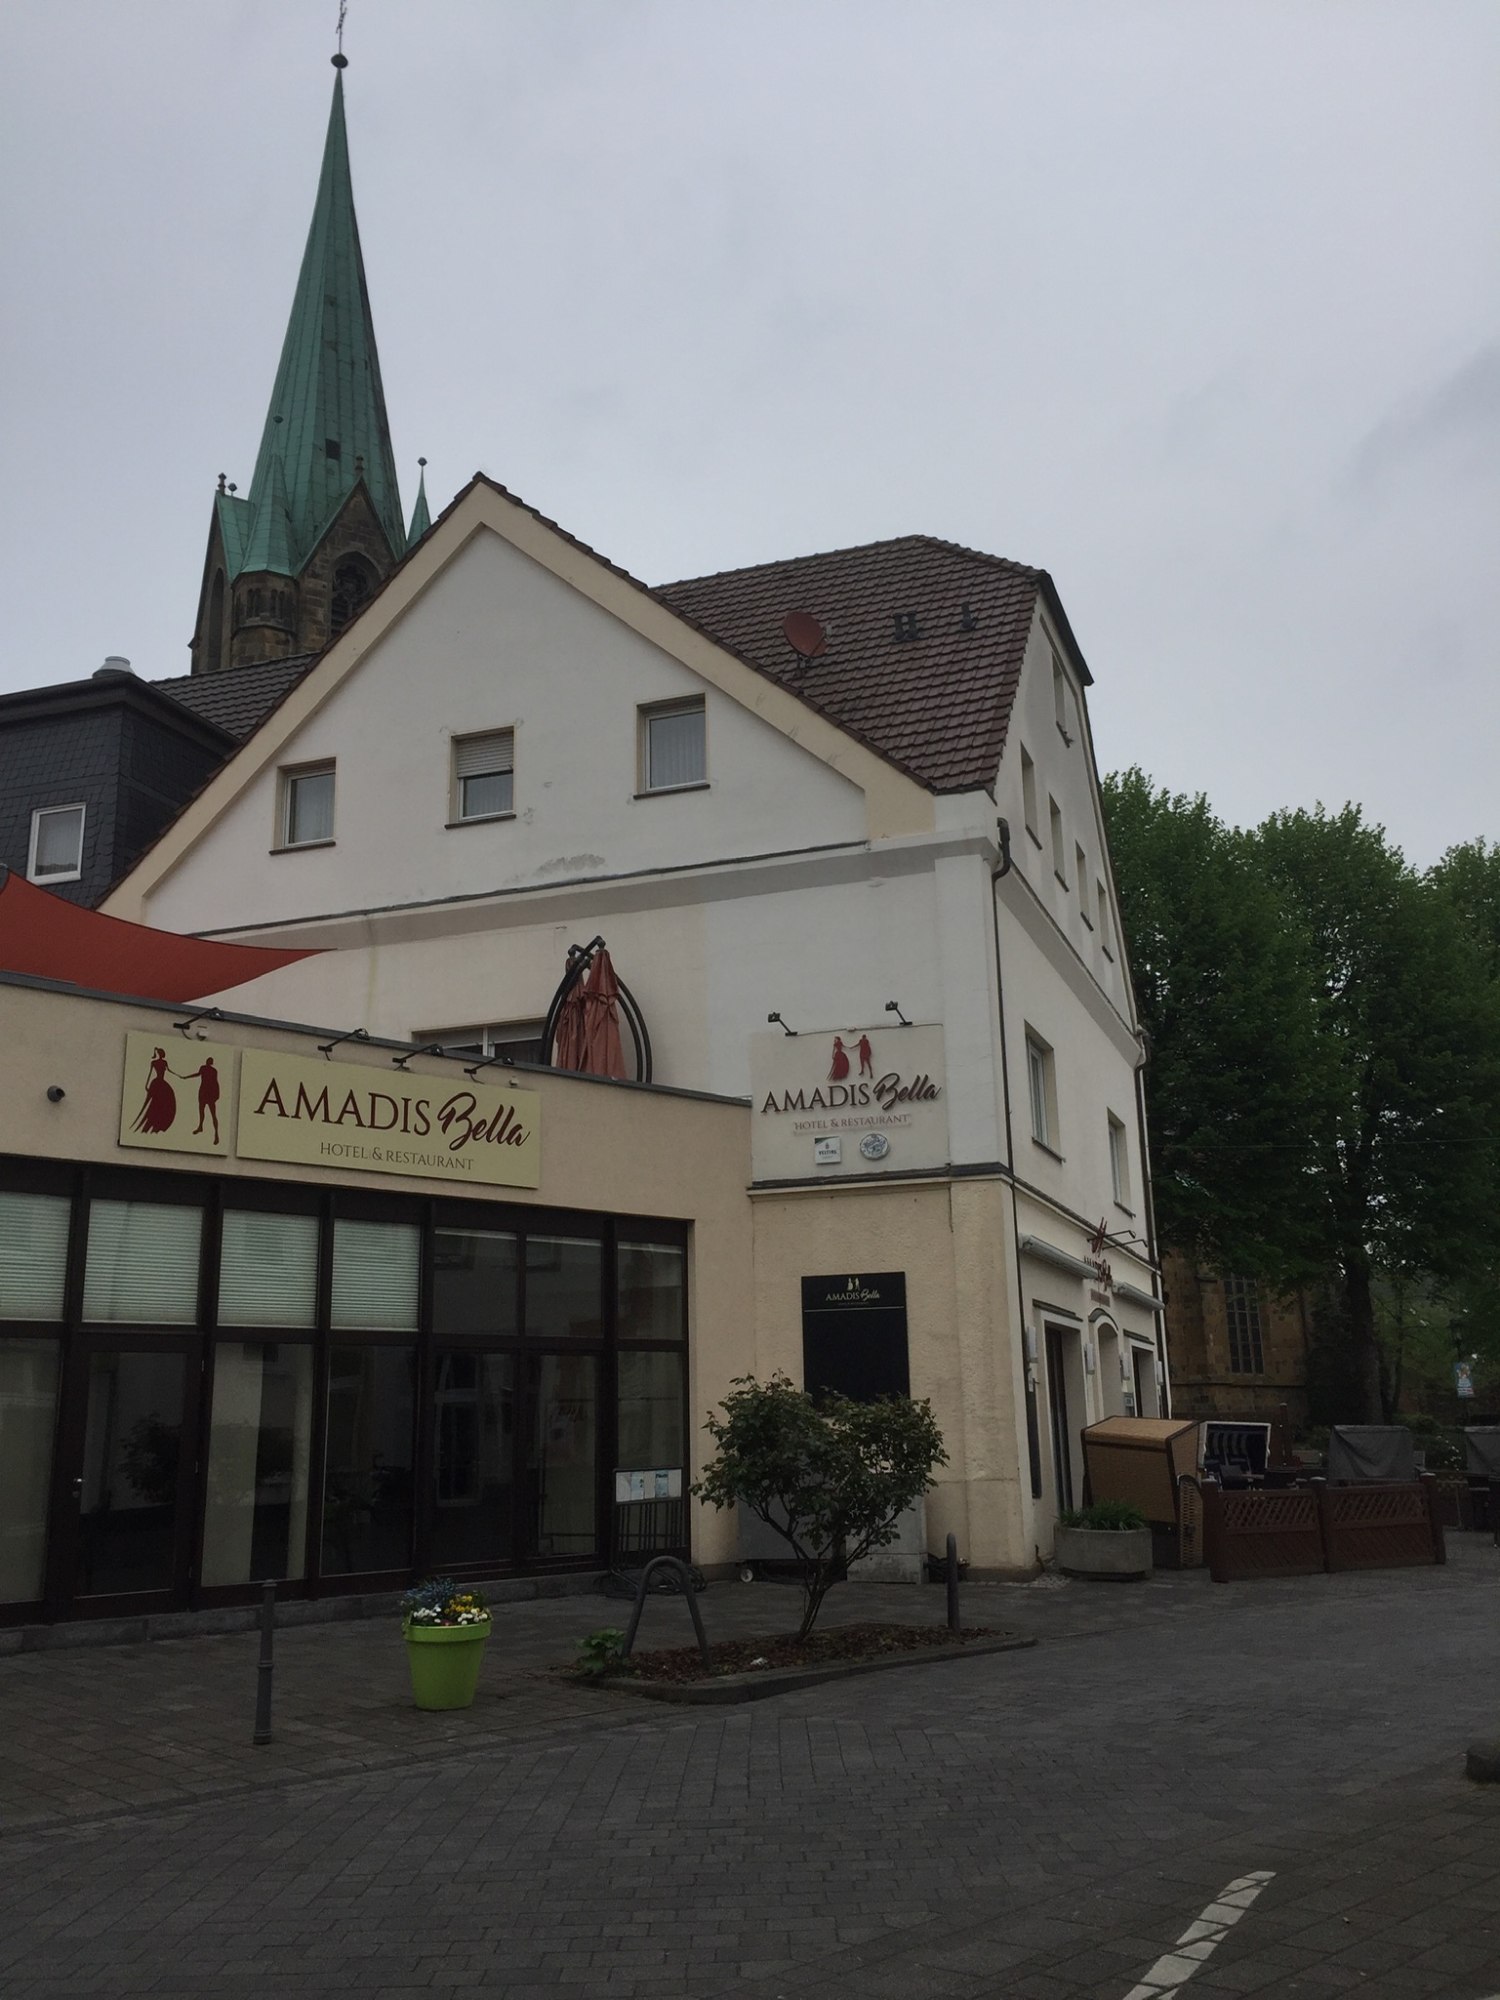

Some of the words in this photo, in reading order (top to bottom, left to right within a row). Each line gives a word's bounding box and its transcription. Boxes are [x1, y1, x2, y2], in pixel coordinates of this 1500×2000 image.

[761, 1083, 870, 1112] AMADIS
[873, 1072, 942, 1111] Bella
[253, 1077, 431, 1136] AMADIS
[437, 1090, 531, 1151] Bella
[794, 1119, 828, 1131] HOTEL
[830, 1118, 841, 1128] &
[841, 1113, 909, 1128] RESTAURANT
[320, 1141, 369, 1160] HOTEL
[371, 1145, 383, 1161] &
[385, 1149, 475, 1171] RESTAURANT
[825, 1292, 860, 1301] AMADIS
[860, 1288, 881, 1302] Bella
